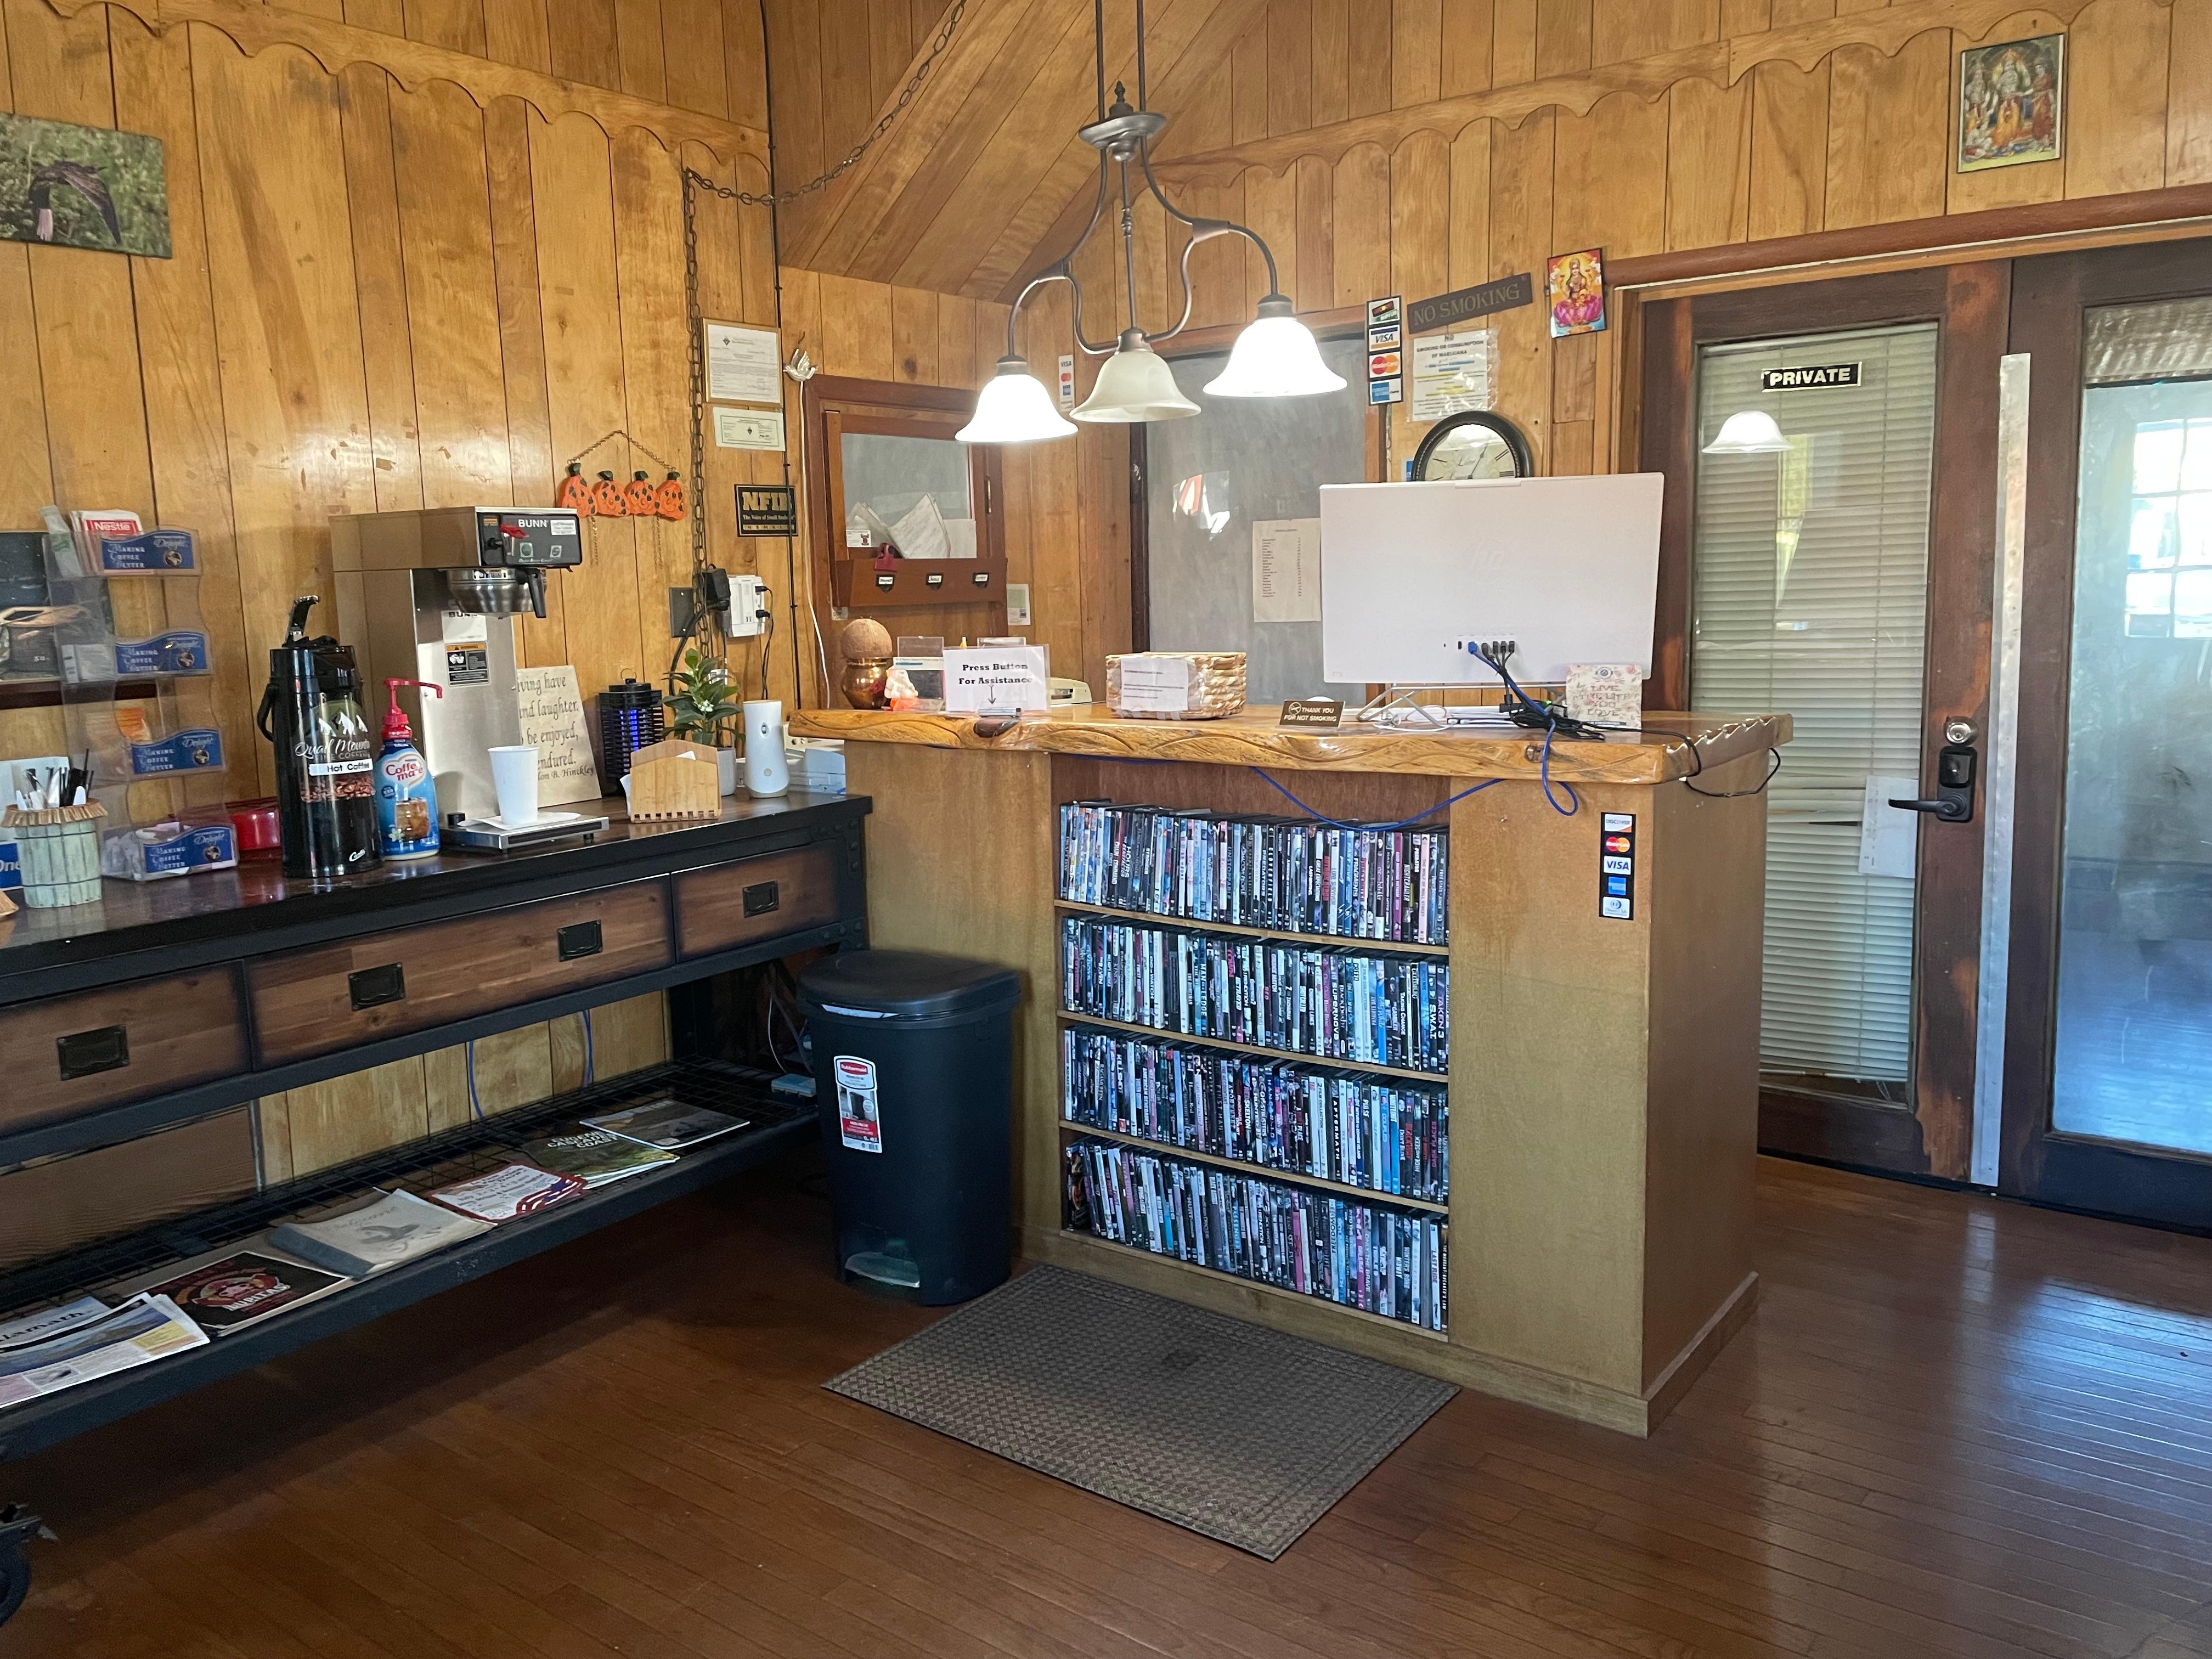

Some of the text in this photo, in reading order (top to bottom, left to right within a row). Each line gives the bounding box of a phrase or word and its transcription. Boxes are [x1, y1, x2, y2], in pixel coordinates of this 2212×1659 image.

[1414, 285, 1520, 326] NO SMOKING
[1375, 334, 1393, 343] VISA
[1770, 368, 1850, 386] PRIVATE
[992, 662, 1028, 670] Button
[544, 673, 566, 689] have
[978, 676, 1033, 685] Assistance
[538, 697, 579, 720] laughter.
[527, 721, 579, 747] be enjoyed,
[386, 761, 420, 776] Coffe
[397, 768, 423, 780] mae
[562, 765, 594, 777] Hinckley
[1607, 861, 1629, 870] VISA
[577, 1137, 618, 1148] COAST
[1232, 1206, 1240, 1254] PASSENGERS
